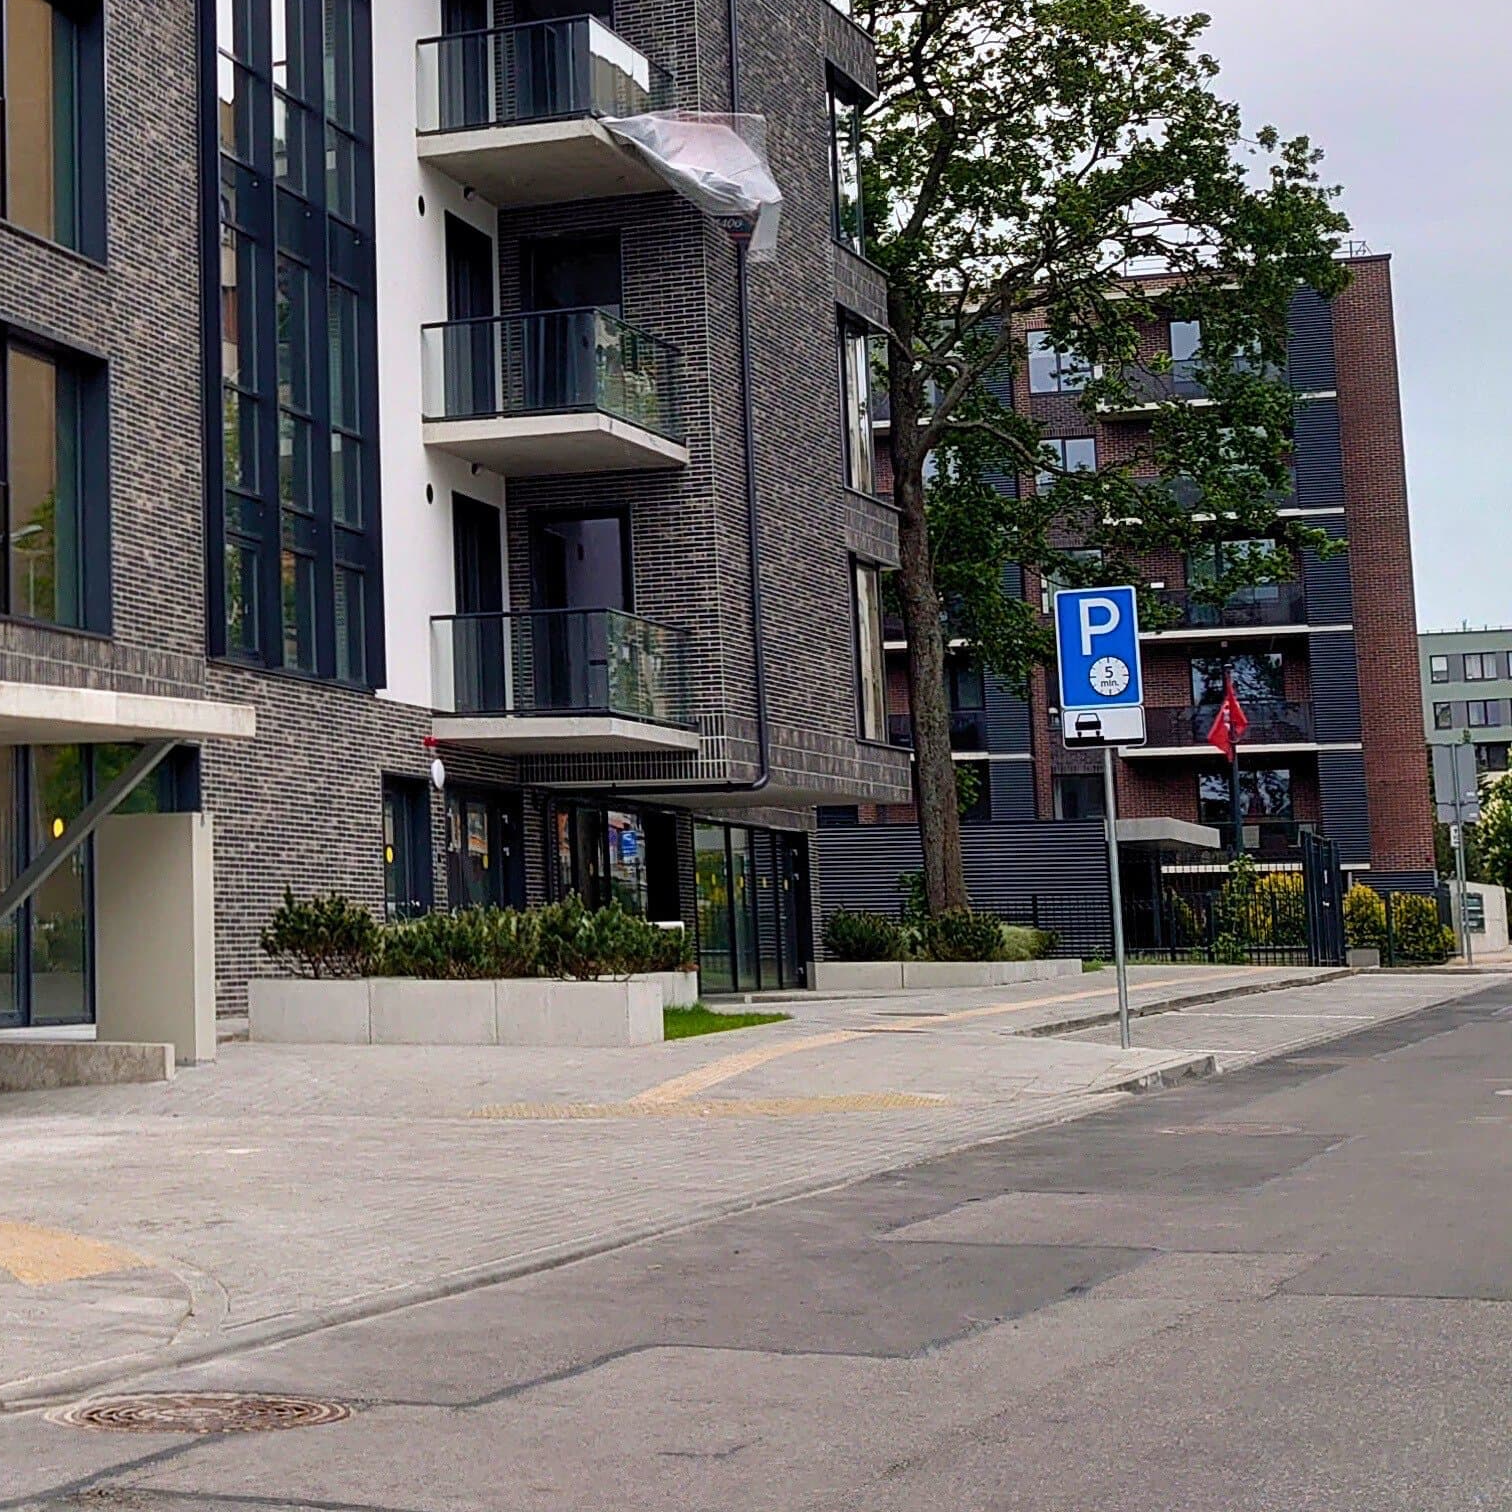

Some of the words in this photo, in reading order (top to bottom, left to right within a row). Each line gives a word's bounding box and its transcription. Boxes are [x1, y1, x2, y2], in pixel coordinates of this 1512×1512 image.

[1079, 597, 1120, 656] P
[1105, 666, 1114, 678] 5
[1100, 679, 1119, 687] min.
